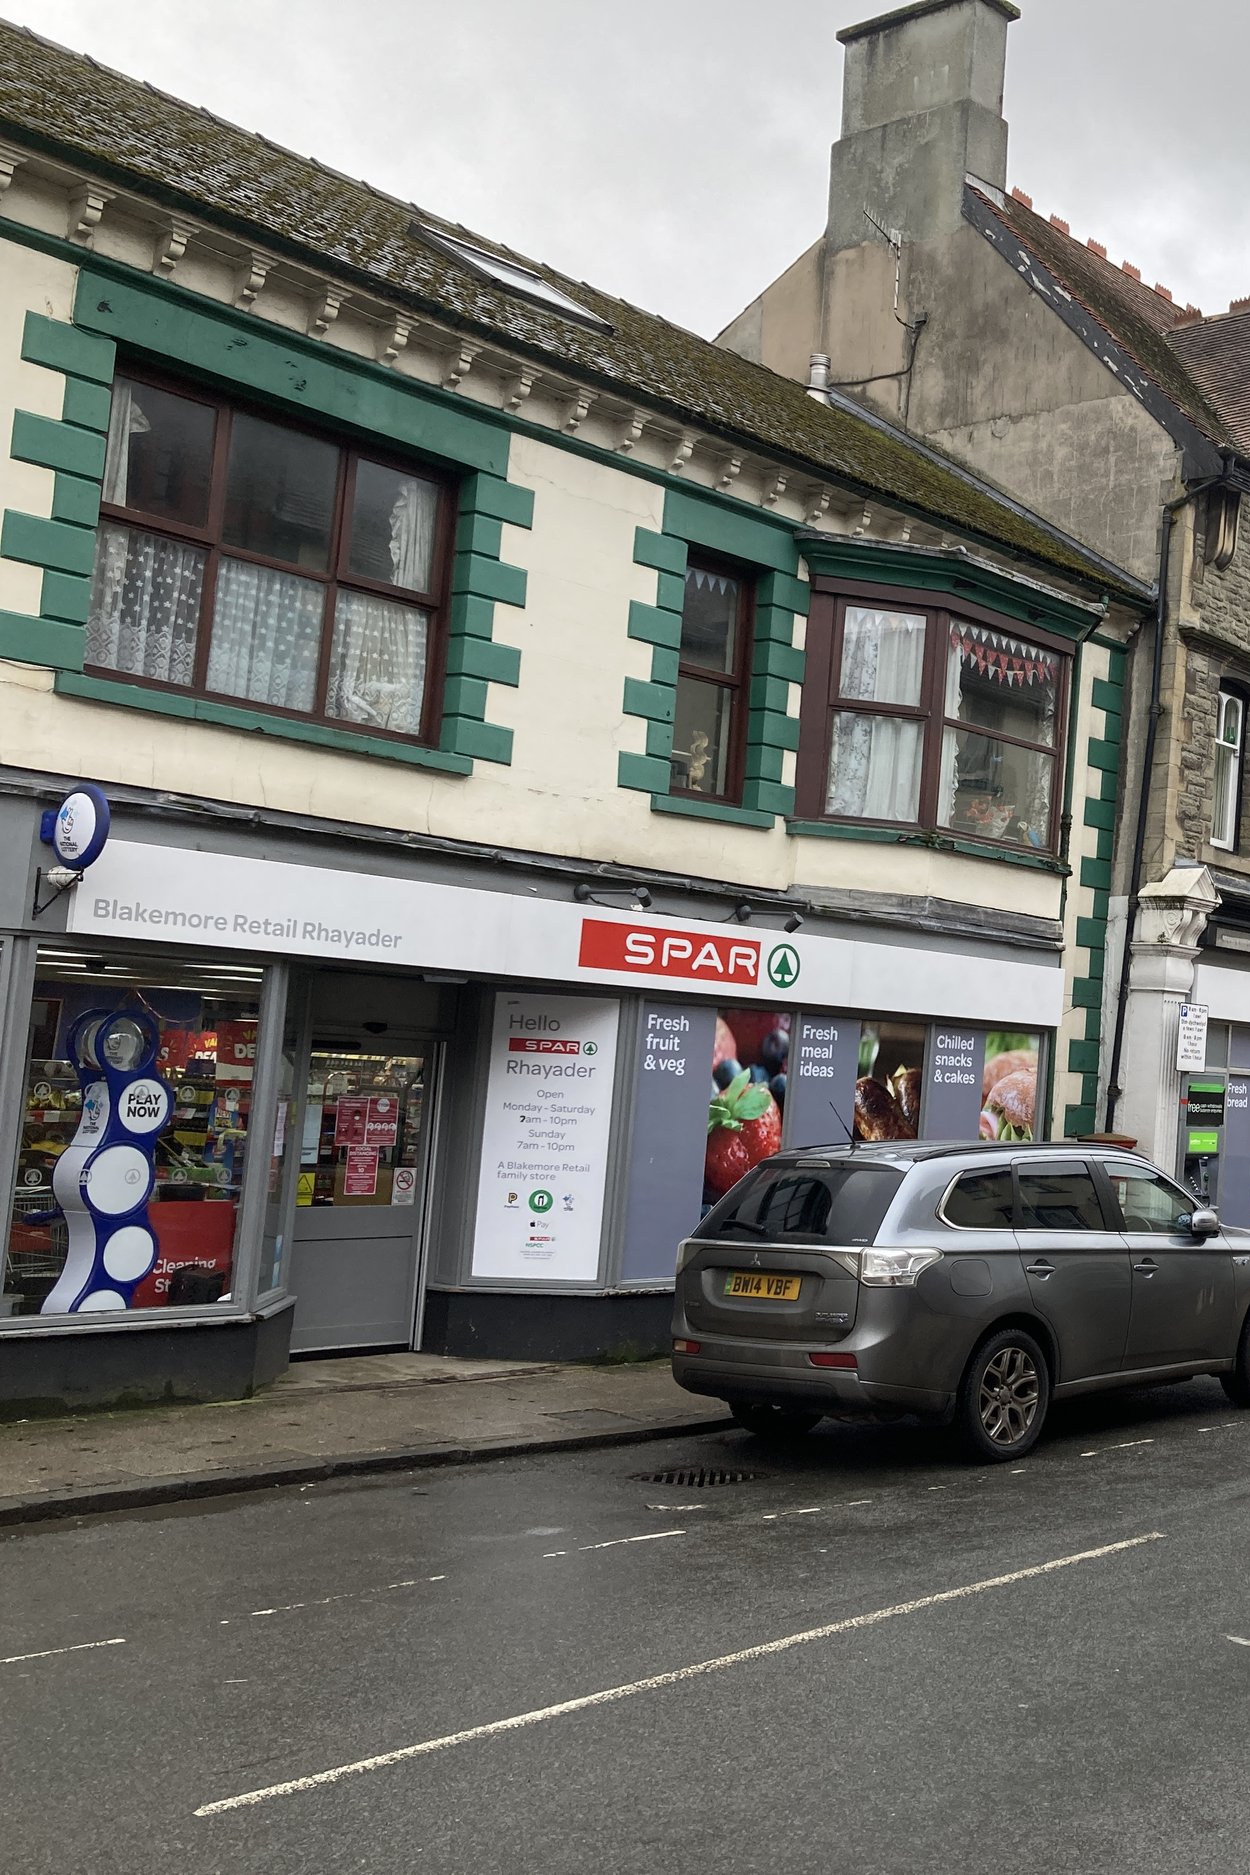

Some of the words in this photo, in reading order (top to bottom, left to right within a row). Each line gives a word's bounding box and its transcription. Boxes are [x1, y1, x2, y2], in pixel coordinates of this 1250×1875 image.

[92, 898, 228, 932] Blakemore
[232, 914, 298, 939] Retail
[302, 922, 402, 948] Rhayader
[624, 932, 757, 978] SPAR
[509, 1014, 560, 1032] Hello
[648, 1014, 690, 1031] Fresh
[803, 1025, 838, 1041] Fresh
[525, 1040, 579, 1052] SPAR
[646, 1034, 680, 1051] fruit
[937, 1035, 974, 1050] Chilled
[802, 1044, 833, 1059] meal
[644, 1054, 656, 1070] &
[658, 1058, 686, 1076] veg
[935, 1053, 972, 1067] snacks
[506, 1060, 596, 1079] Rhayader
[800, 1061, 834, 1077] ideas
[934, 1069, 942, 1082] &
[944, 1070, 975, 1084] cakes
[536, 1089, 564, 1099] Open
[1227, 1082, 1247, 1094] Fresh
[128, 1093, 162, 1105] PLAY
[1227, 1097, 1248, 1108] bread
[127, 1106, 160, 1118] NOW
[503, 1102, 542, 1113] Monday
[550, 1104, 596, 1116] Saturday
[520, 1115, 541, 1124] 7am
[550, 1116, 577, 1126] 10pm
[528, 1129, 566, 1140] Sunday
[517, 1141, 539, 1150] 7am
[547, 1142, 575, 1152] 10pm
[497, 1161, 504, 1169] A
[507, 1161, 560, 1171] Blakemore
[562, 1164, 590, 1172] Retail
[497, 1170, 528, 1181] family
[530, 1172, 556, 1180] store
[536, 1221, 550, 1229] Pay
[732, 1277, 762, 1295] BW14
[767, 1279, 792, 1296] VBF
